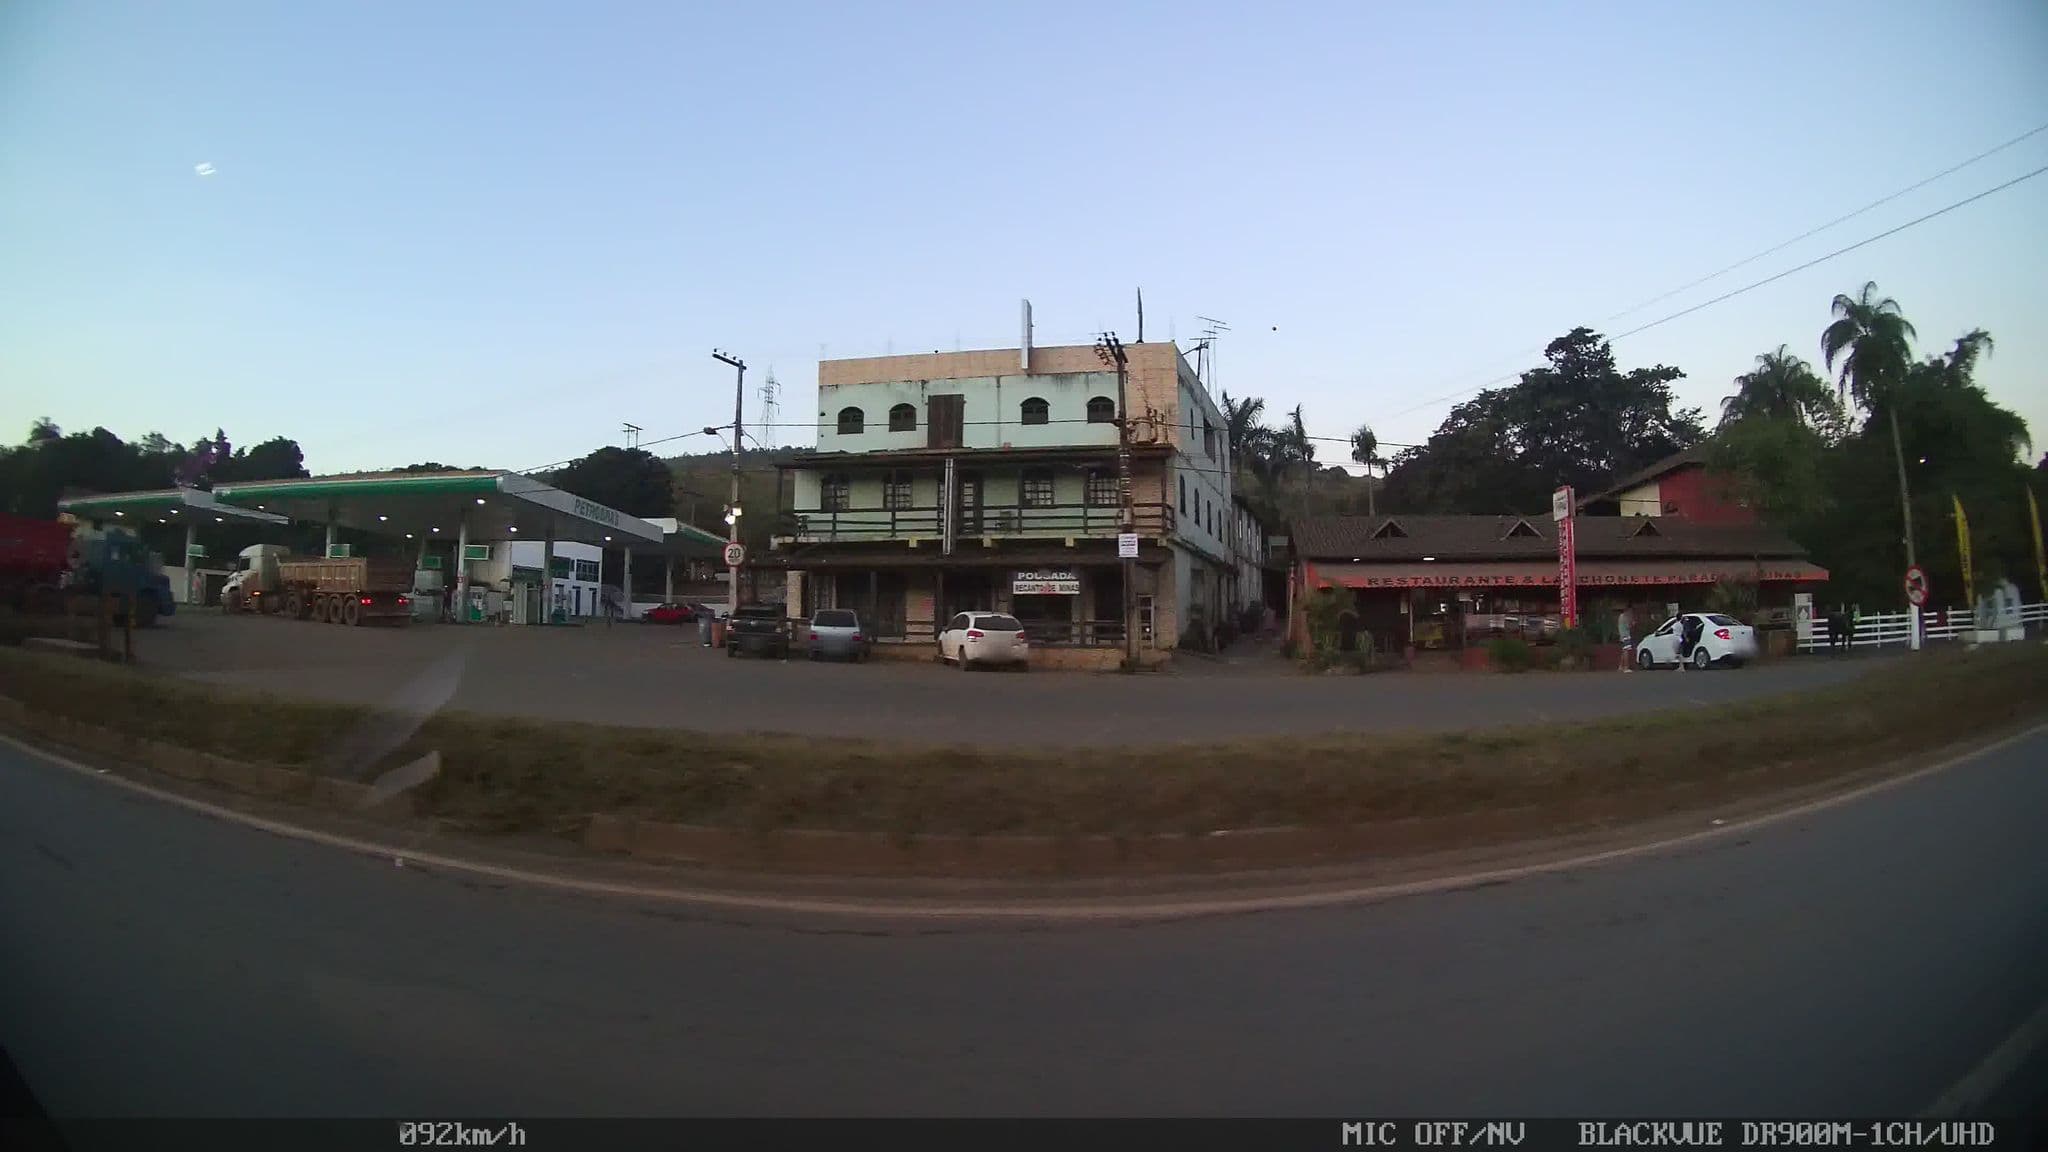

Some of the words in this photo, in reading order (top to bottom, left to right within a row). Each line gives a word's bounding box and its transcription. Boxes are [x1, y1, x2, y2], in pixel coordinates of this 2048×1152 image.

[727, 547, 741, 559] 20
[1367, 576, 1515, 586] RESTAURANTE
[1522, 576, 1533, 584] &
[1541, 575, 1662, 584] LACHONETE
